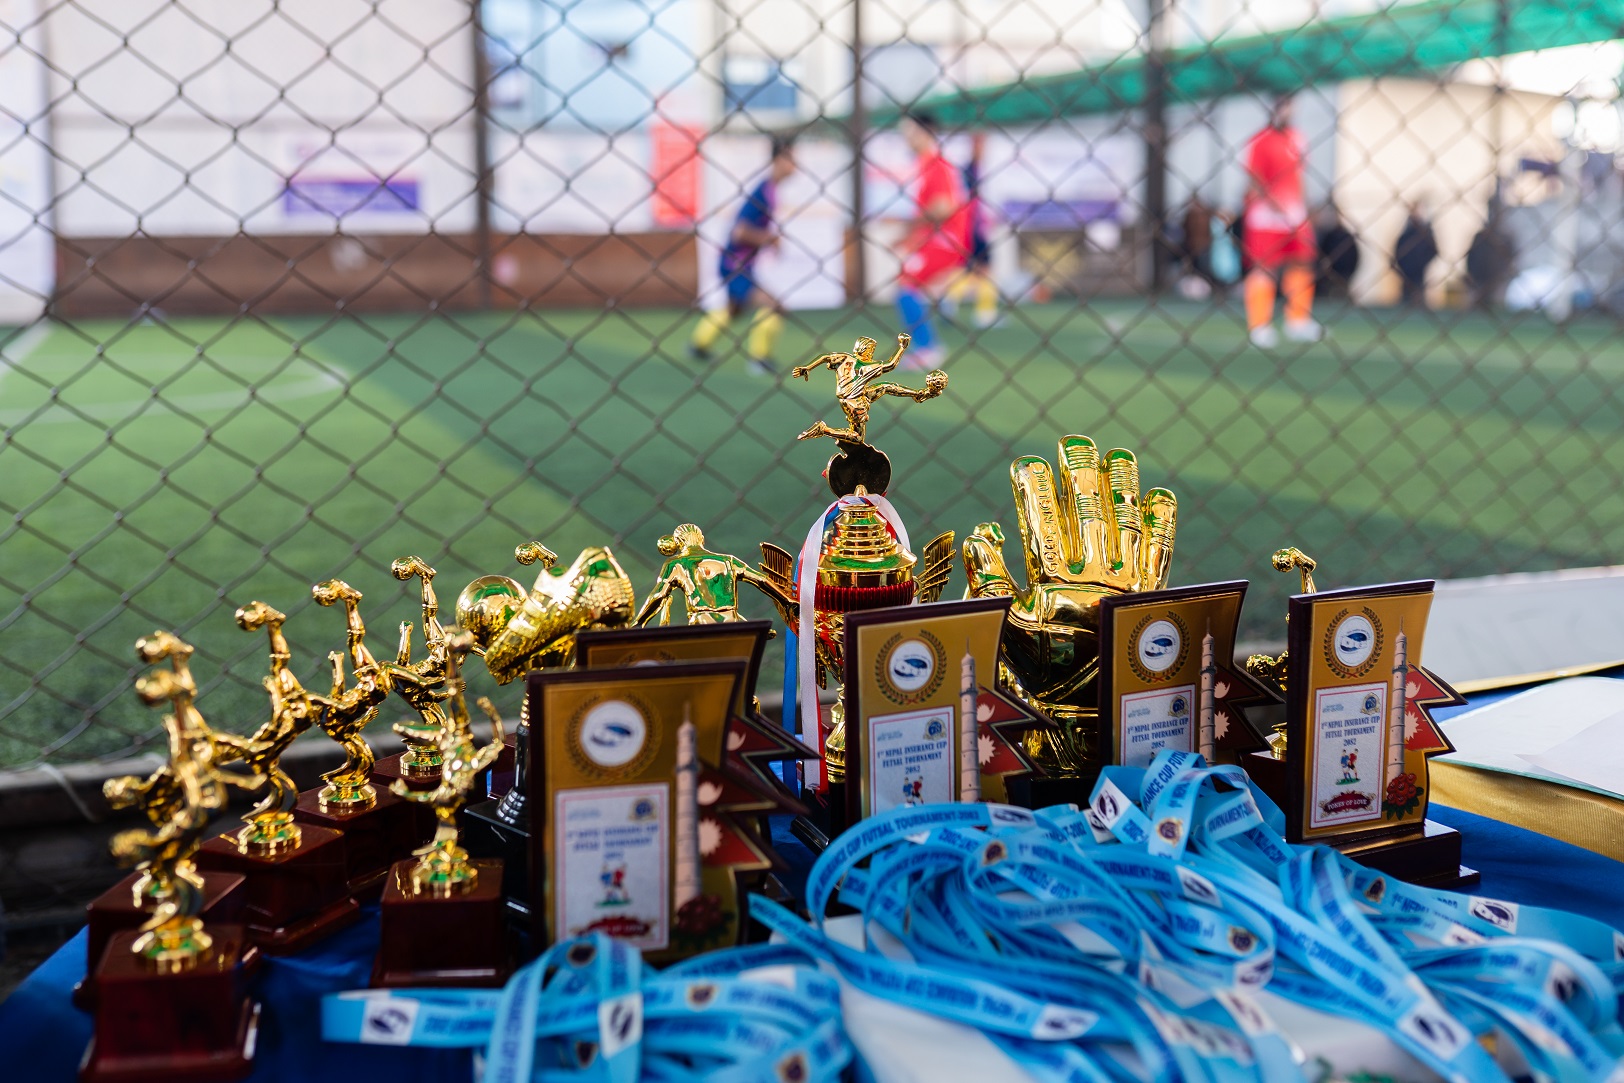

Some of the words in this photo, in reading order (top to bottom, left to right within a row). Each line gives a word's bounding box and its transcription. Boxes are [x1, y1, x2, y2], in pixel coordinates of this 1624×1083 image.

[1344, 717, 1369, 726] INSURANCE
[1158, 764, 1175, 784] CUP
[846, 834, 862, 856] CUP
[861, 820, 895, 846] FUTSAL
